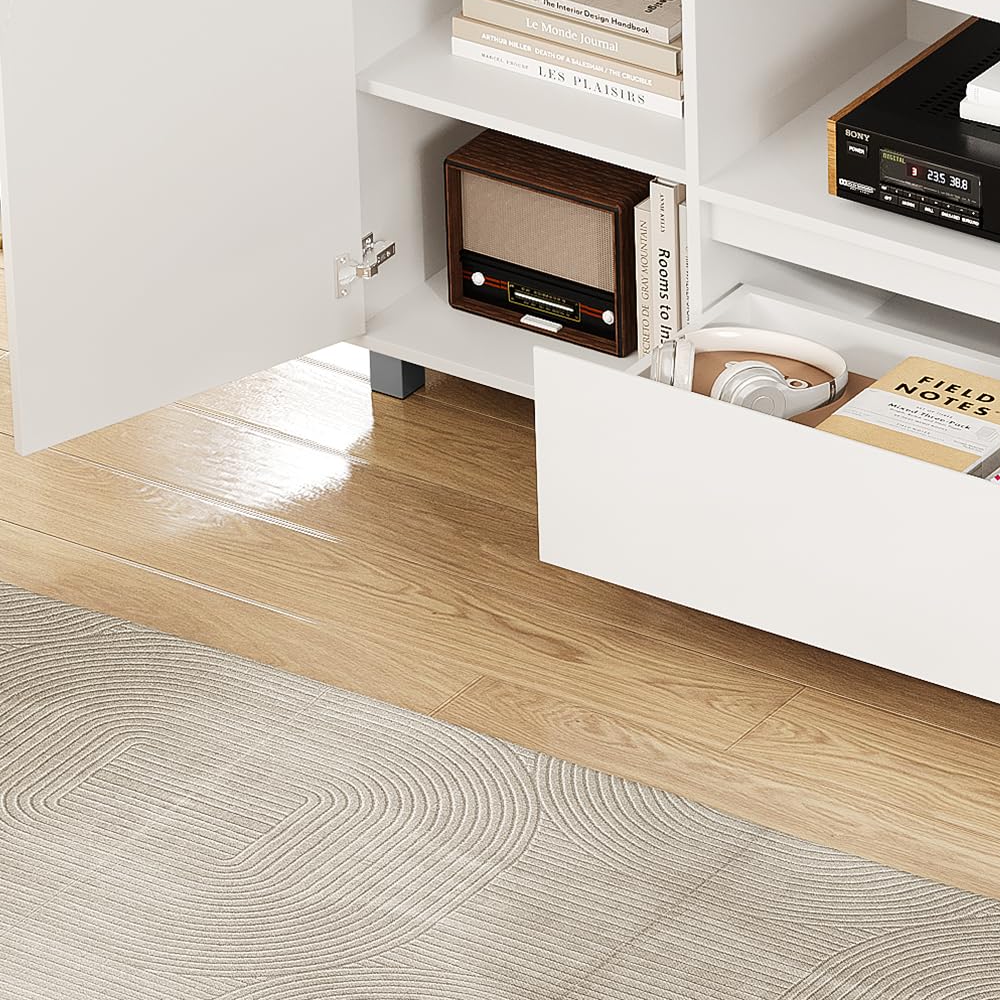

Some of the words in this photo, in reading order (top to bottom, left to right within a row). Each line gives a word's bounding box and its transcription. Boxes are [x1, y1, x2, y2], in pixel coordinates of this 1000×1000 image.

[556, 2, 582, 15] Interior
[583, 9, 609, 24] Design
[611, 17, 650, 34] Handbook
[481, 33, 507, 46] ARTHUR
[509, 40, 531, 52] MILLER
[534, 47, 555, 59] DEATH
[526, 17, 538, 30] Le
[541, 22, 578, 41] Monde
[580, 33, 619, 52] Journal
[538, 65, 565, 82] LES
[573, 75, 646, 105] PLAISIRS
[845, 128, 870, 142] SONY
[911, 166, 918, 177] 3
[927, 169, 946, 184] 23.5
[640, 220, 649, 274] MOUNTAIN
[641, 274, 650, 300] GRAY
[658, 248, 671, 300] Rooms
[641, 303, 650, 318] DE
[660, 304, 671, 321] to
[642, 319, 651, 355] ECRETO
[660, 324, 673, 345] In
[894, 383, 992, 416] NOTES
[917, 376, 995, 403] FIELD
[888, 402, 918, 414] Mixed
